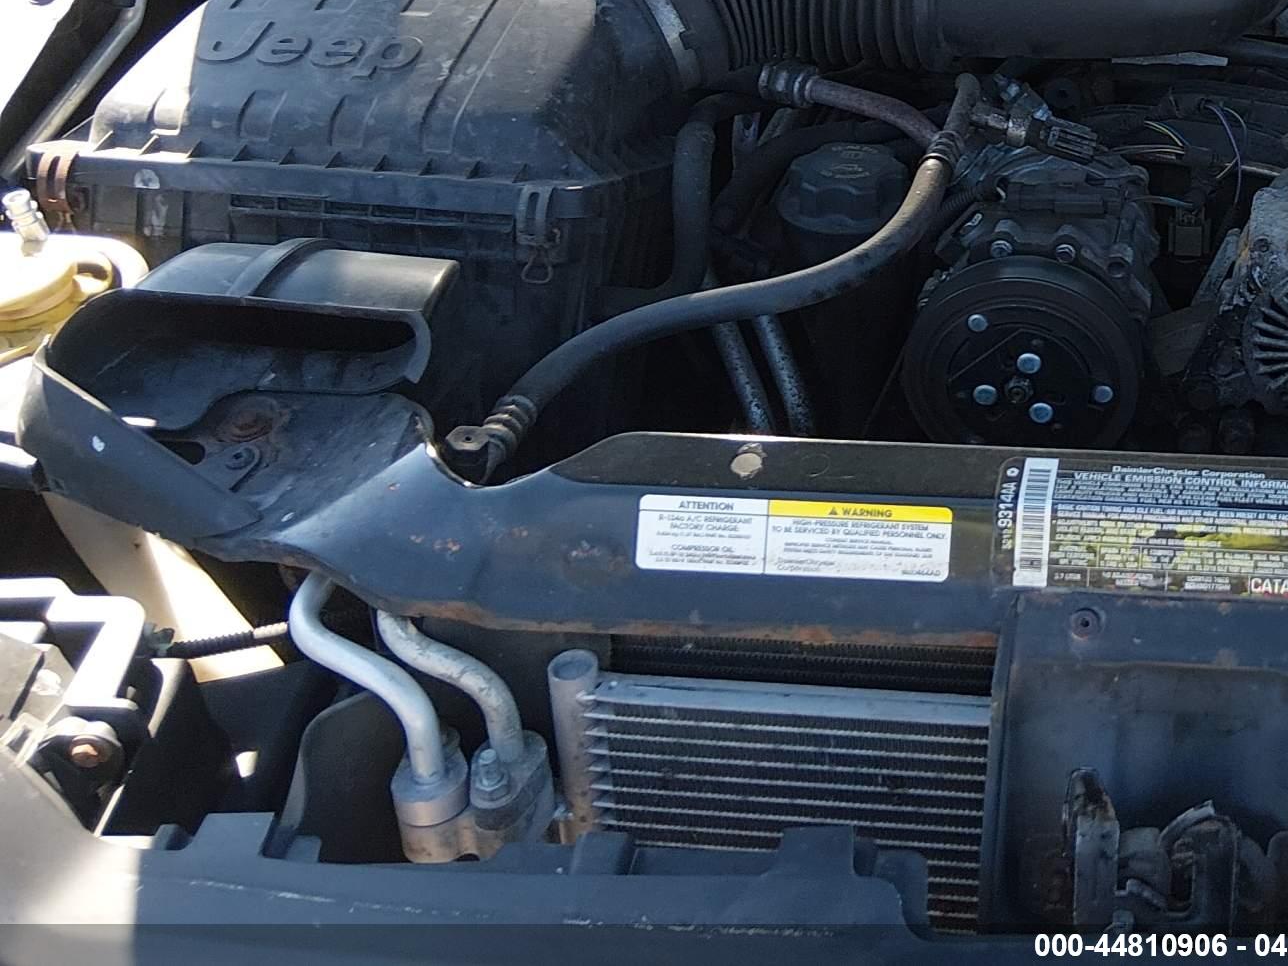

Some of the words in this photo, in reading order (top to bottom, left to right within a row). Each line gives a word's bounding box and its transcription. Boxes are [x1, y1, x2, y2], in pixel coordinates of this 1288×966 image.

[196, 20, 424, 81] Jeep
[1074, 472, 1121, 481] VEHICLE
[1125, 474, 1182, 484] EMISSION
[1185, 478, 1237, 487] CONTROL
[1202, 469, 1266, 479] Corporation
[678, 501, 734, 511] ATTENTION
[842, 507, 893, 518] WARNING
[851, 522, 899, 530] REFRIGERANT
[794, 526, 829, 535] SERVICED
[843, 529, 881, 537] QUALIFIED
[883, 530, 924, 539] PERSONNEL
